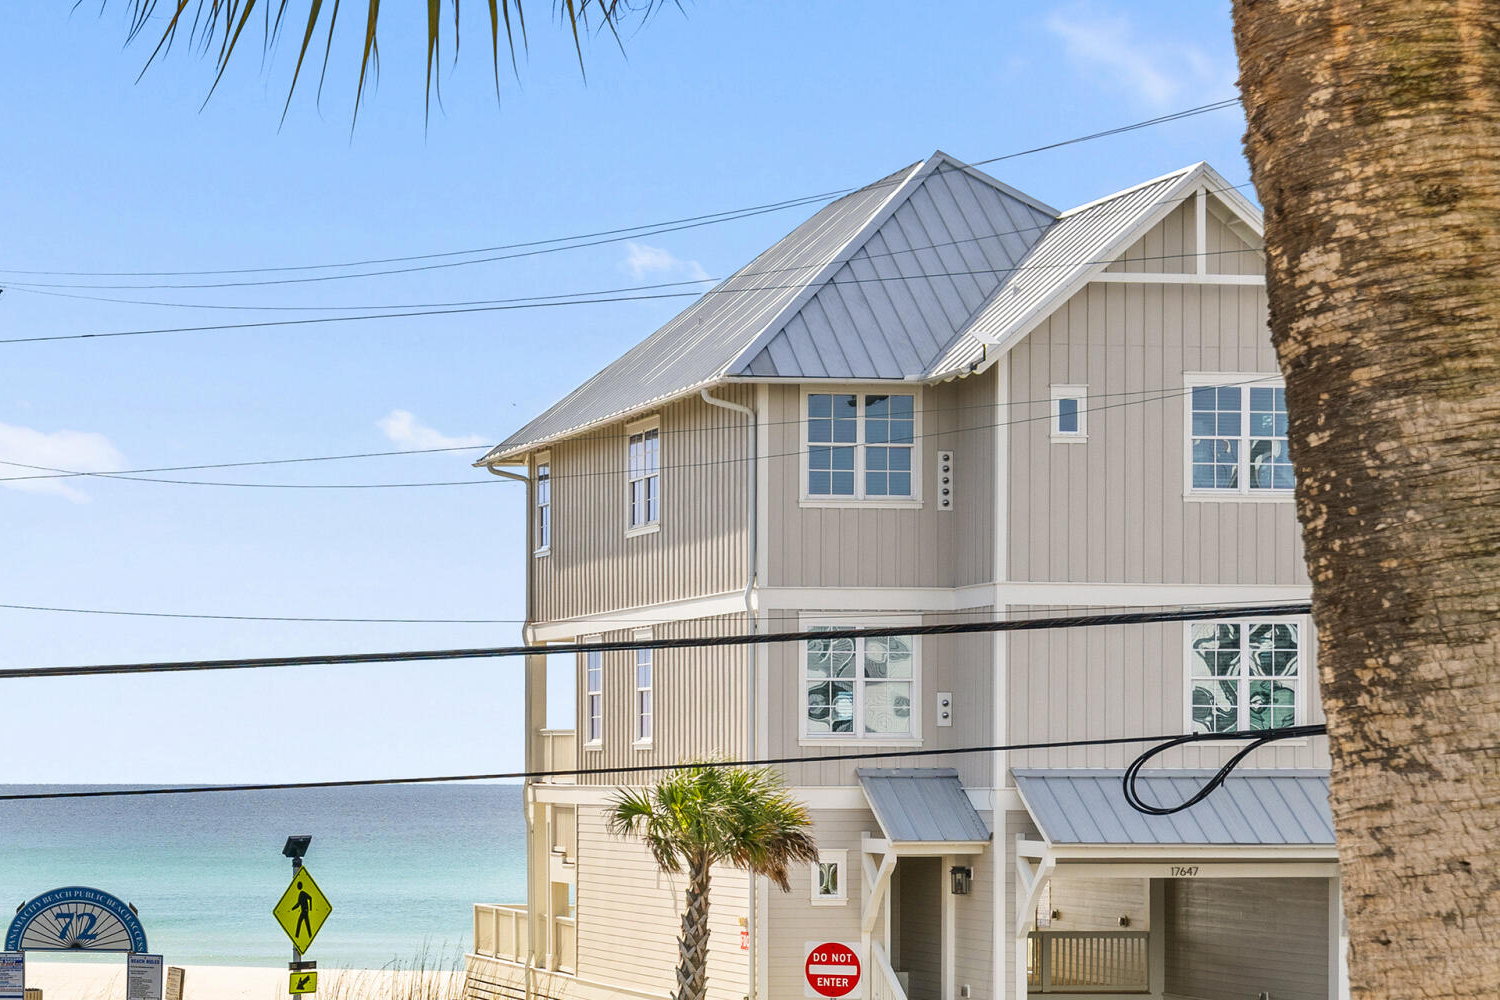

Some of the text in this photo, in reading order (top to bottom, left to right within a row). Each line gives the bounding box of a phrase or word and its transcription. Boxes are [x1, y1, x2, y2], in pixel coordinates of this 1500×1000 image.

[1171, 866, 1199, 877] 17647
[8, 890, 145, 952] PANAMA CITY BEACH PUBLIC BEACH ACCESS
[54, 912, 99, 940] 72
[813, 952, 853, 963] DO NOT
[817, 977, 849, 987] ENTER
